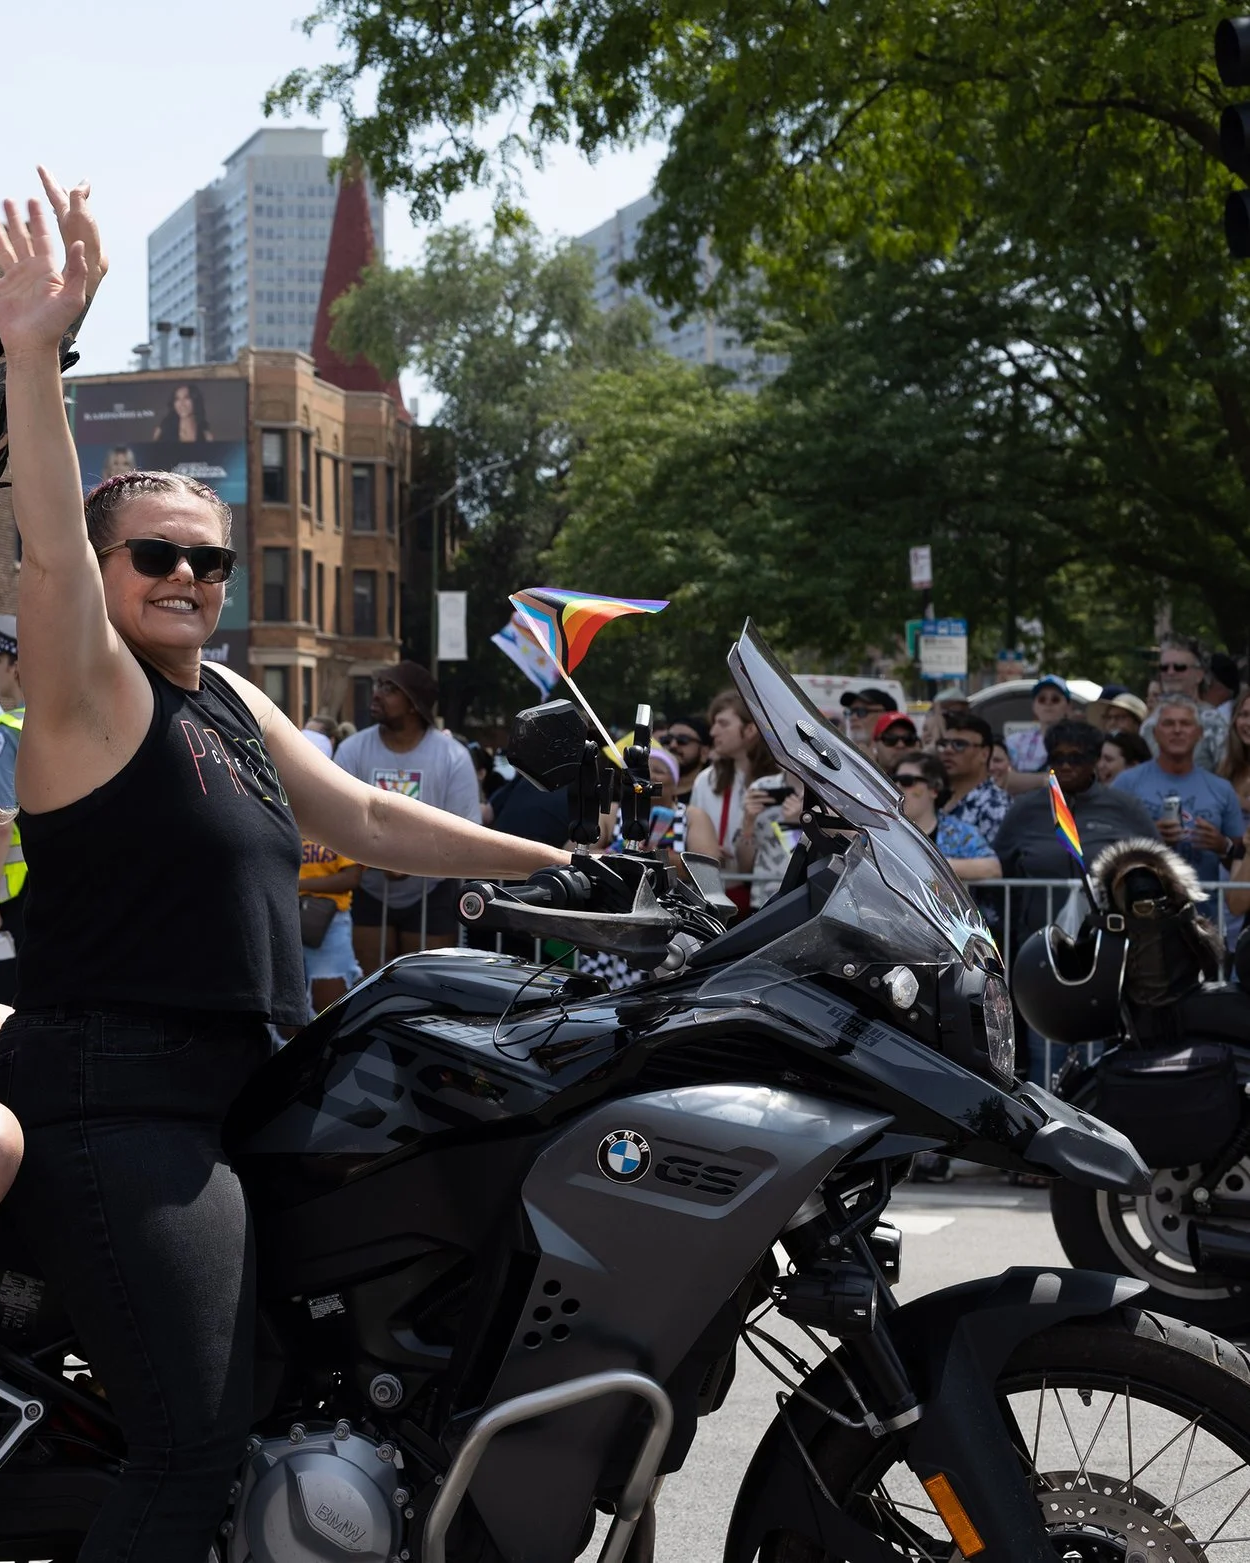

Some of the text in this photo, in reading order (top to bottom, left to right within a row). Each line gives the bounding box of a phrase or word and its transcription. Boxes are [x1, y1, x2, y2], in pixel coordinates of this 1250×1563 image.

[606, 1131, 649, 1153] BMW
[654, 1155, 744, 1196] GS
[314, 1501, 367, 1544] BMW
